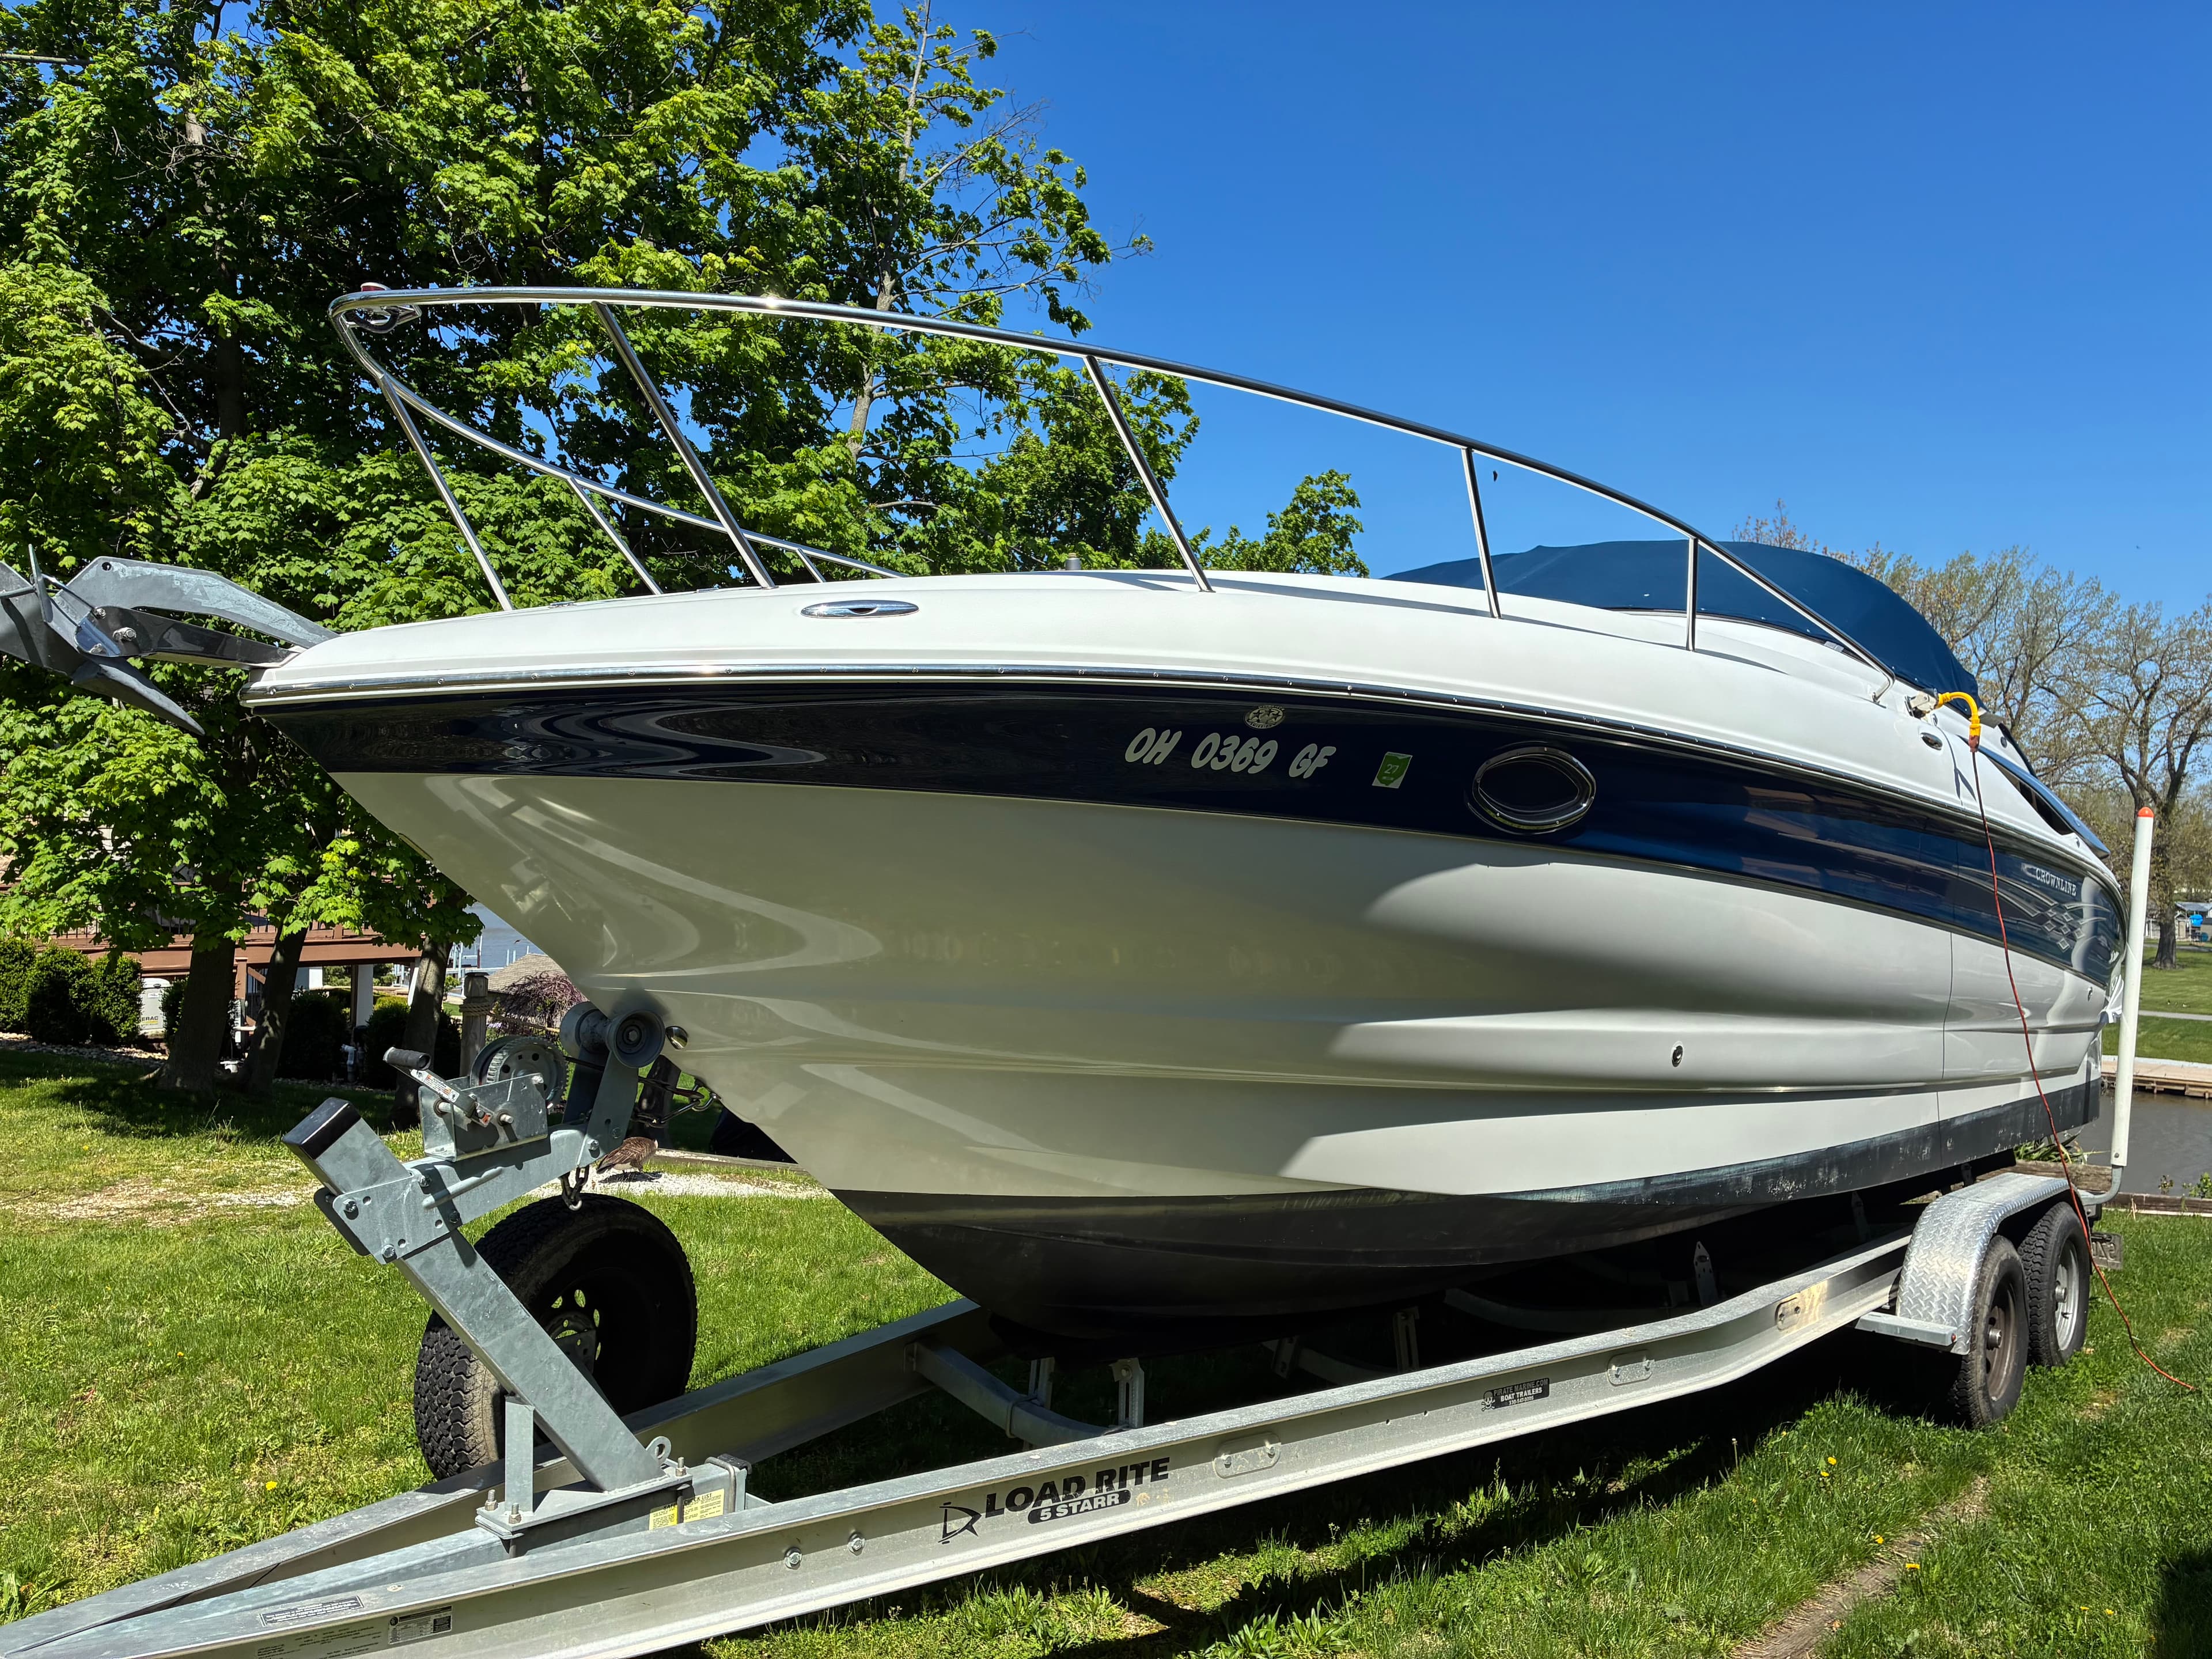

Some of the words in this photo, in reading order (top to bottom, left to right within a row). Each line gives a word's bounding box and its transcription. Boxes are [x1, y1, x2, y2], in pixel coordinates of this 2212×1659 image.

[1124, 728, 1181, 764] OH
[1191, 733, 1278, 774] 0369
[1289, 743, 1336, 778] GF
[1384, 763, 1399, 774] 27
[2036, 868, 2077, 896] CROWNLINE
[1493, 1386, 1513, 1396] PIRATE
[1501, 1393, 1515, 1402] BOAT
[1516, 1387, 1543, 1398] TRAILERS
[702, 1493, 713, 1501] LIST
[985, 1475, 1086, 1518] LOAD
[1096, 1457, 1170, 1494] RITE
[1039, 1508, 1052, 1521] 5
[1056, 1490, 1120, 1517] STARR
